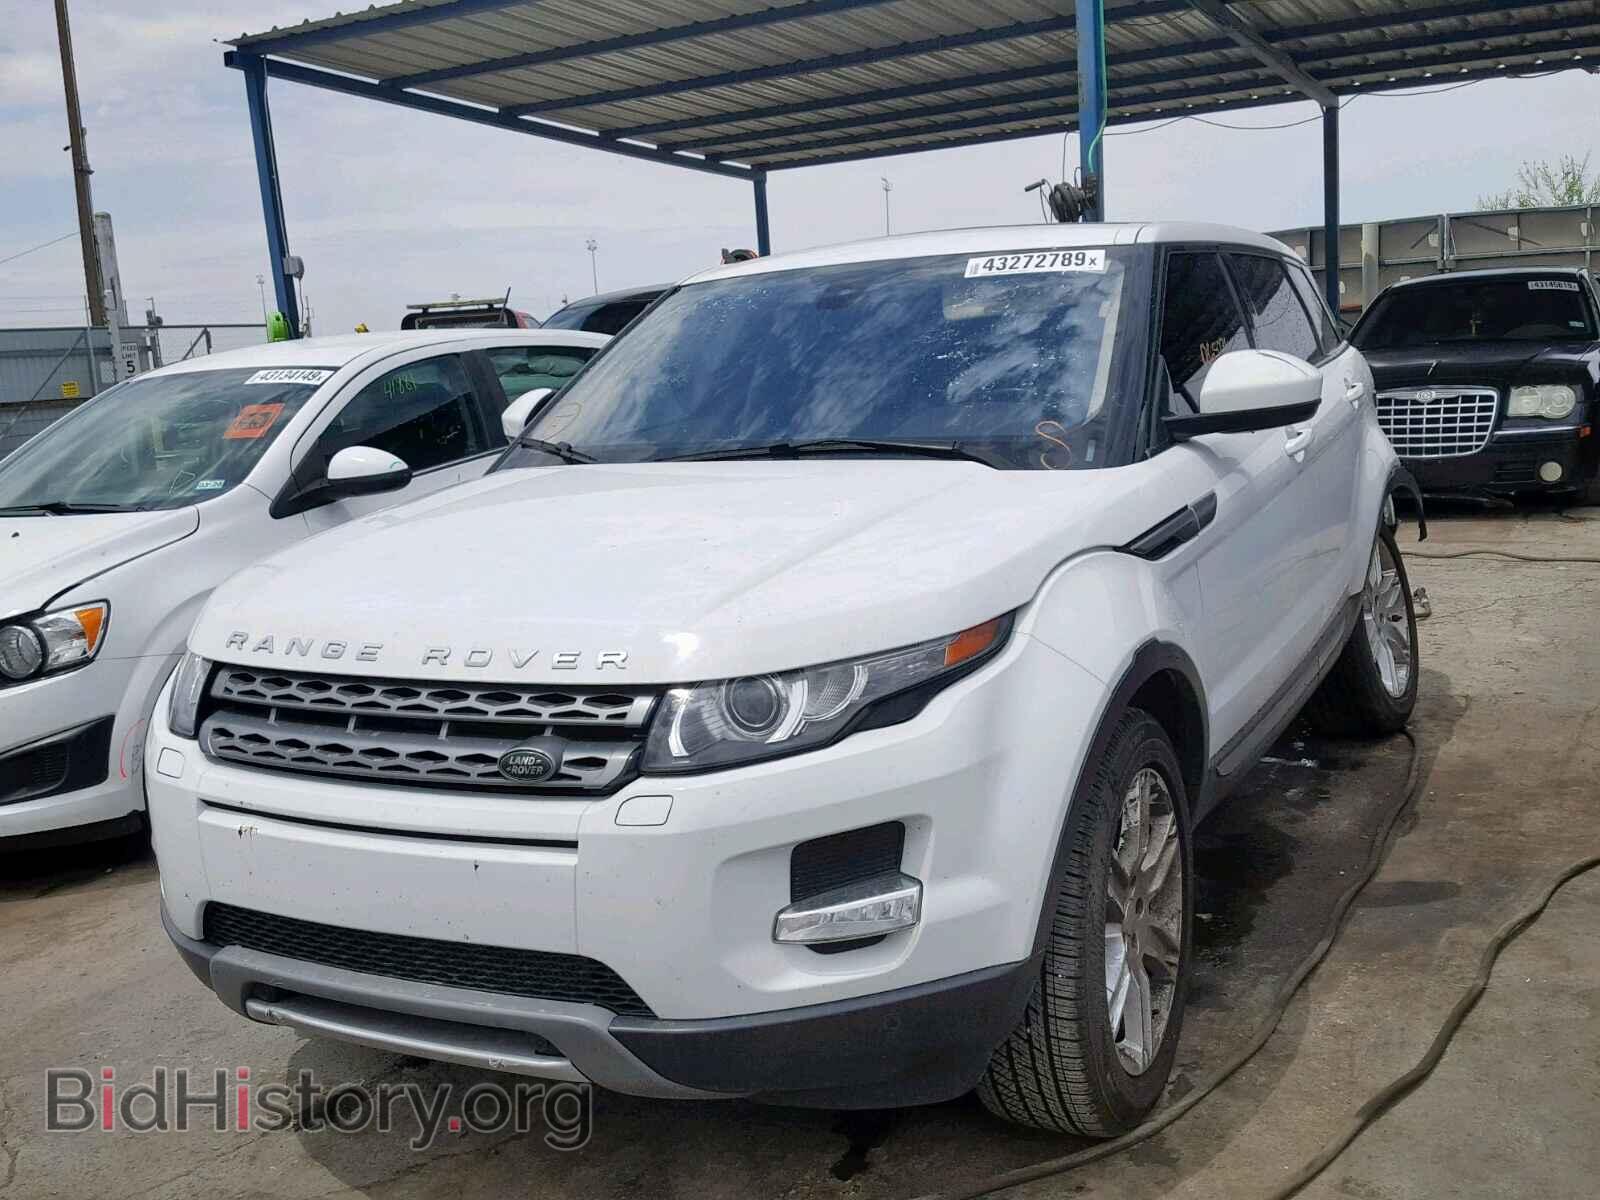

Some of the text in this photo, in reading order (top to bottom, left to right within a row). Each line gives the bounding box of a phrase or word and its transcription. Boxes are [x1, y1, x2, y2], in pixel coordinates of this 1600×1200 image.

[126, 360, 136, 374] 5
[225, 630, 630, 671] RANGE ROVER
[511, 765, 543, 775] ROVER
